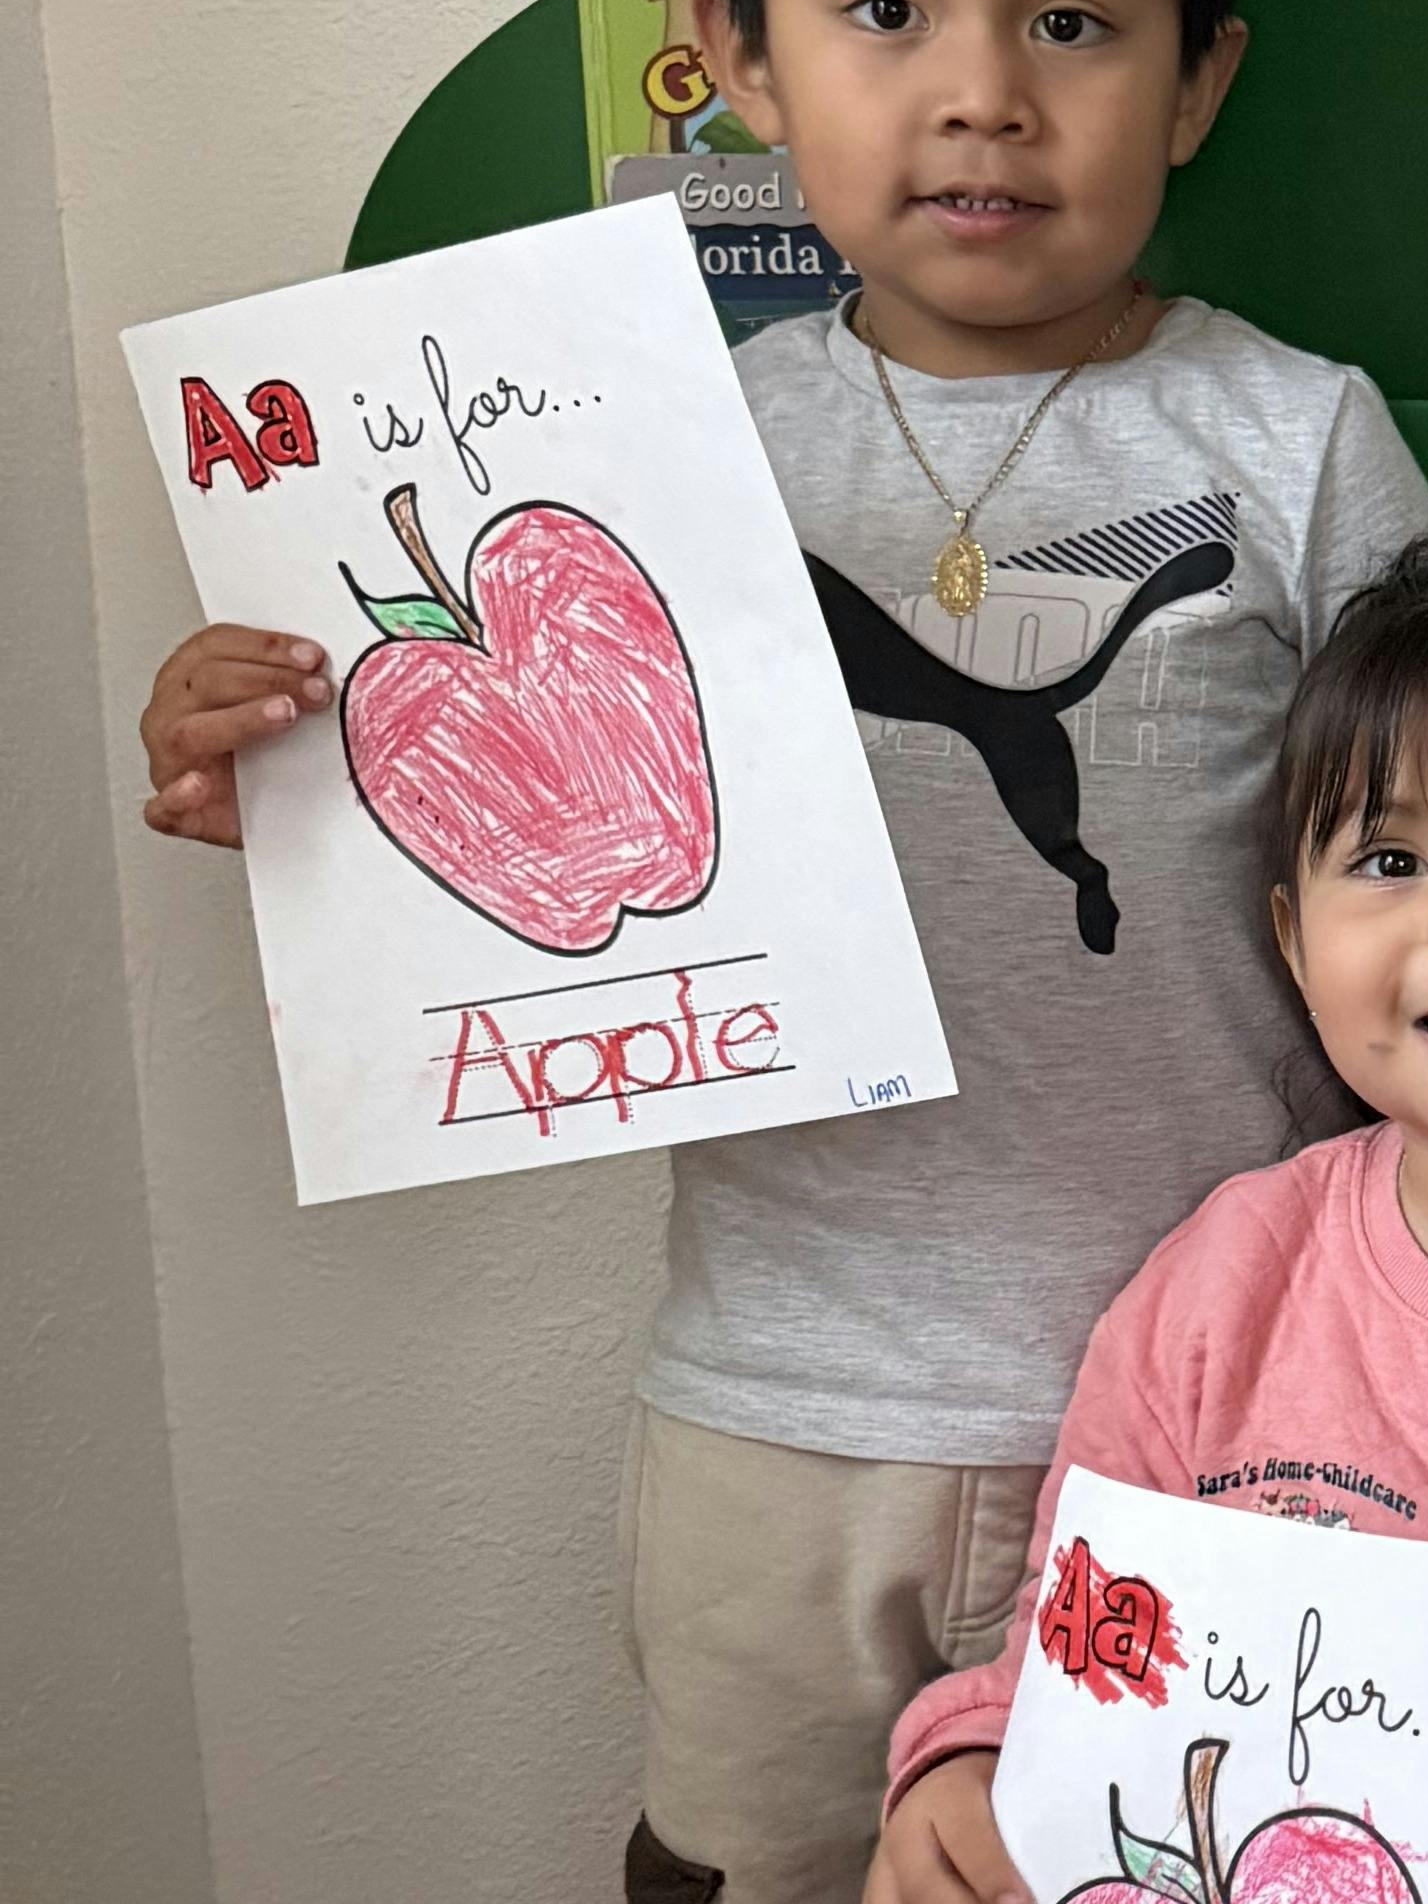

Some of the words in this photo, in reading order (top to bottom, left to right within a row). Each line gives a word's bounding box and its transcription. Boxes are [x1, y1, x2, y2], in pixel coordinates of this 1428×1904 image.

[680, 172, 782, 210] Good
[180, 376, 319, 493] Aa
[355, 393, 424, 452] is
[417, 336, 602, 496] for...
[441, 968, 782, 1138] Apple
[849, 1075, 912, 1108] LIAM
[1196, 1461, 1259, 1498] Sara's
[1262, 1457, 1418, 1521] Home-Childcare
[1042, 1535, 1159, 1681] Aa
[1204, 1631, 1269, 1706] is
